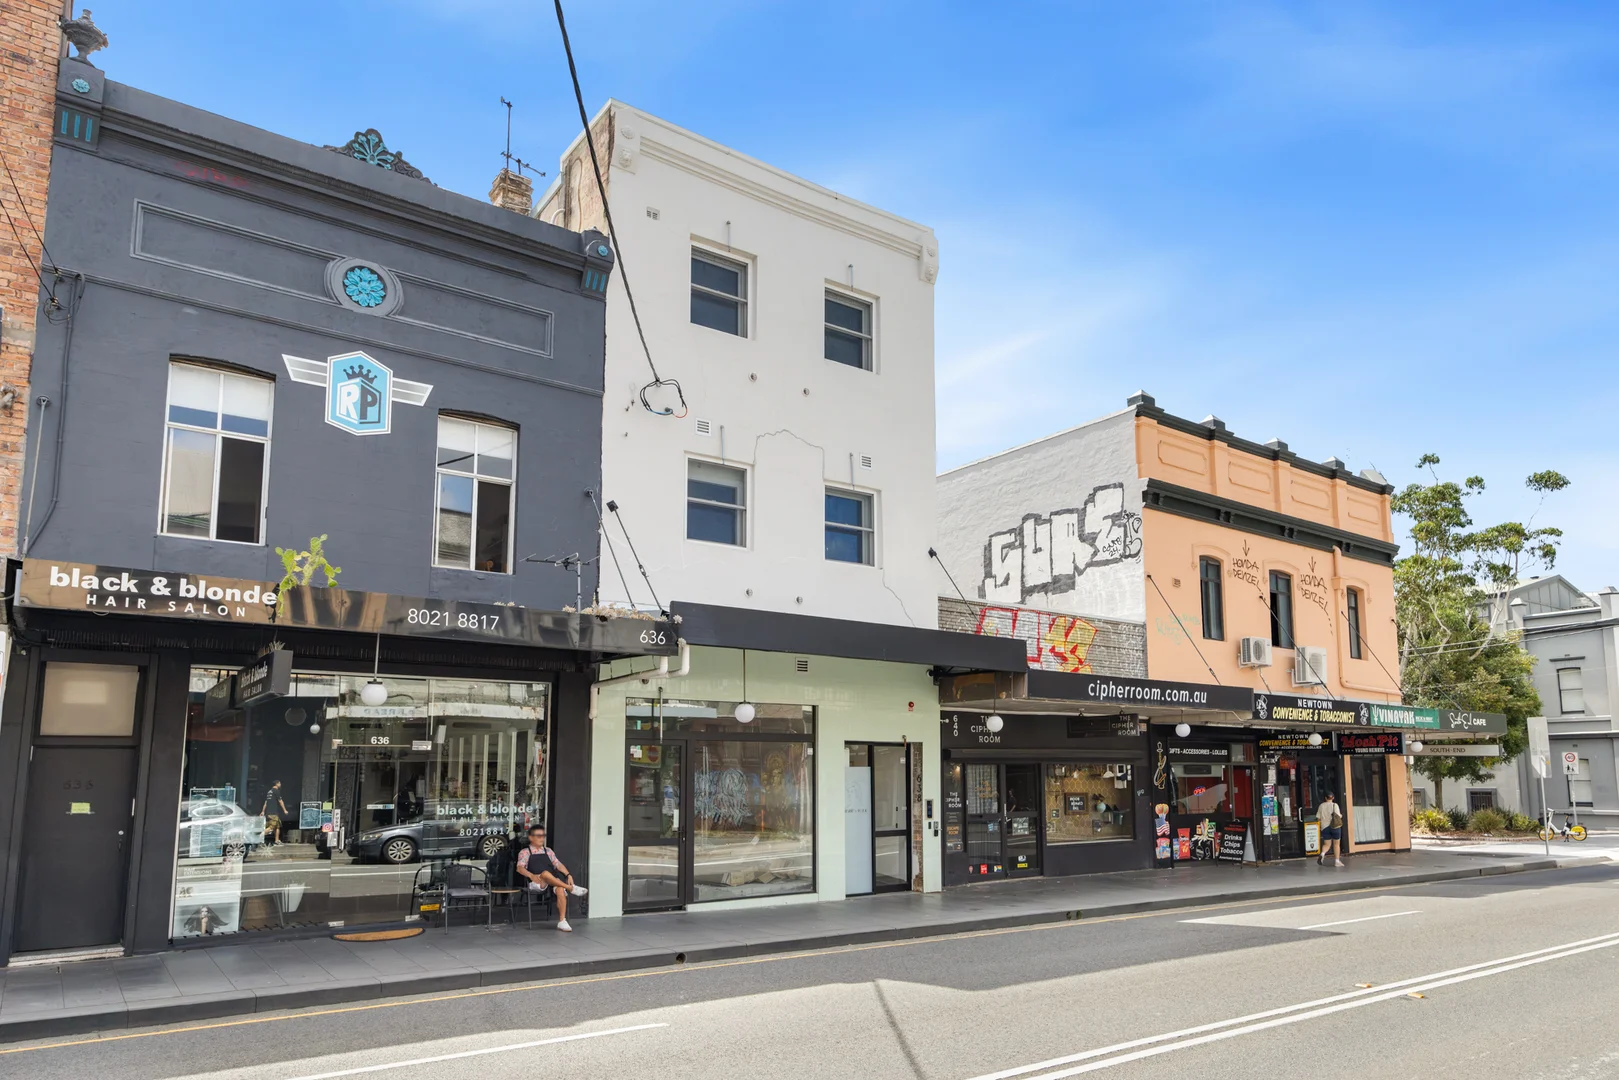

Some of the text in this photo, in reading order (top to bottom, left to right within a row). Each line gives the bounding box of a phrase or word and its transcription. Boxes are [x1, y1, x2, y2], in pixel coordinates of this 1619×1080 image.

[340, 383, 378, 420] RP
[1232, 558, 1260, 572] HONDA
[50, 566, 278, 605] black & blonde
[1300, 574, 1328, 594] HONDA
[86, 594, 246, 617] HAIR SALON
[407, 608, 500, 631] 8021 8817
[640, 630, 666, 644] 636
[1088, 680, 1207, 704] cipherroom.com.au
[1298, 698, 1332, 710] NEWTOWN
[1272, 706, 1355, 724] CONVENIENCE & TOBACCONIST
[1378, 708, 1415, 724] VINAYAK
[1473, 718, 1486, 726] CAFE
[371, 736, 390, 745] 636
[1341, 735, 1398, 748] Mosh Pit
[436, 803, 533, 815] black & blonde
[460, 827, 510, 836] 80218817
